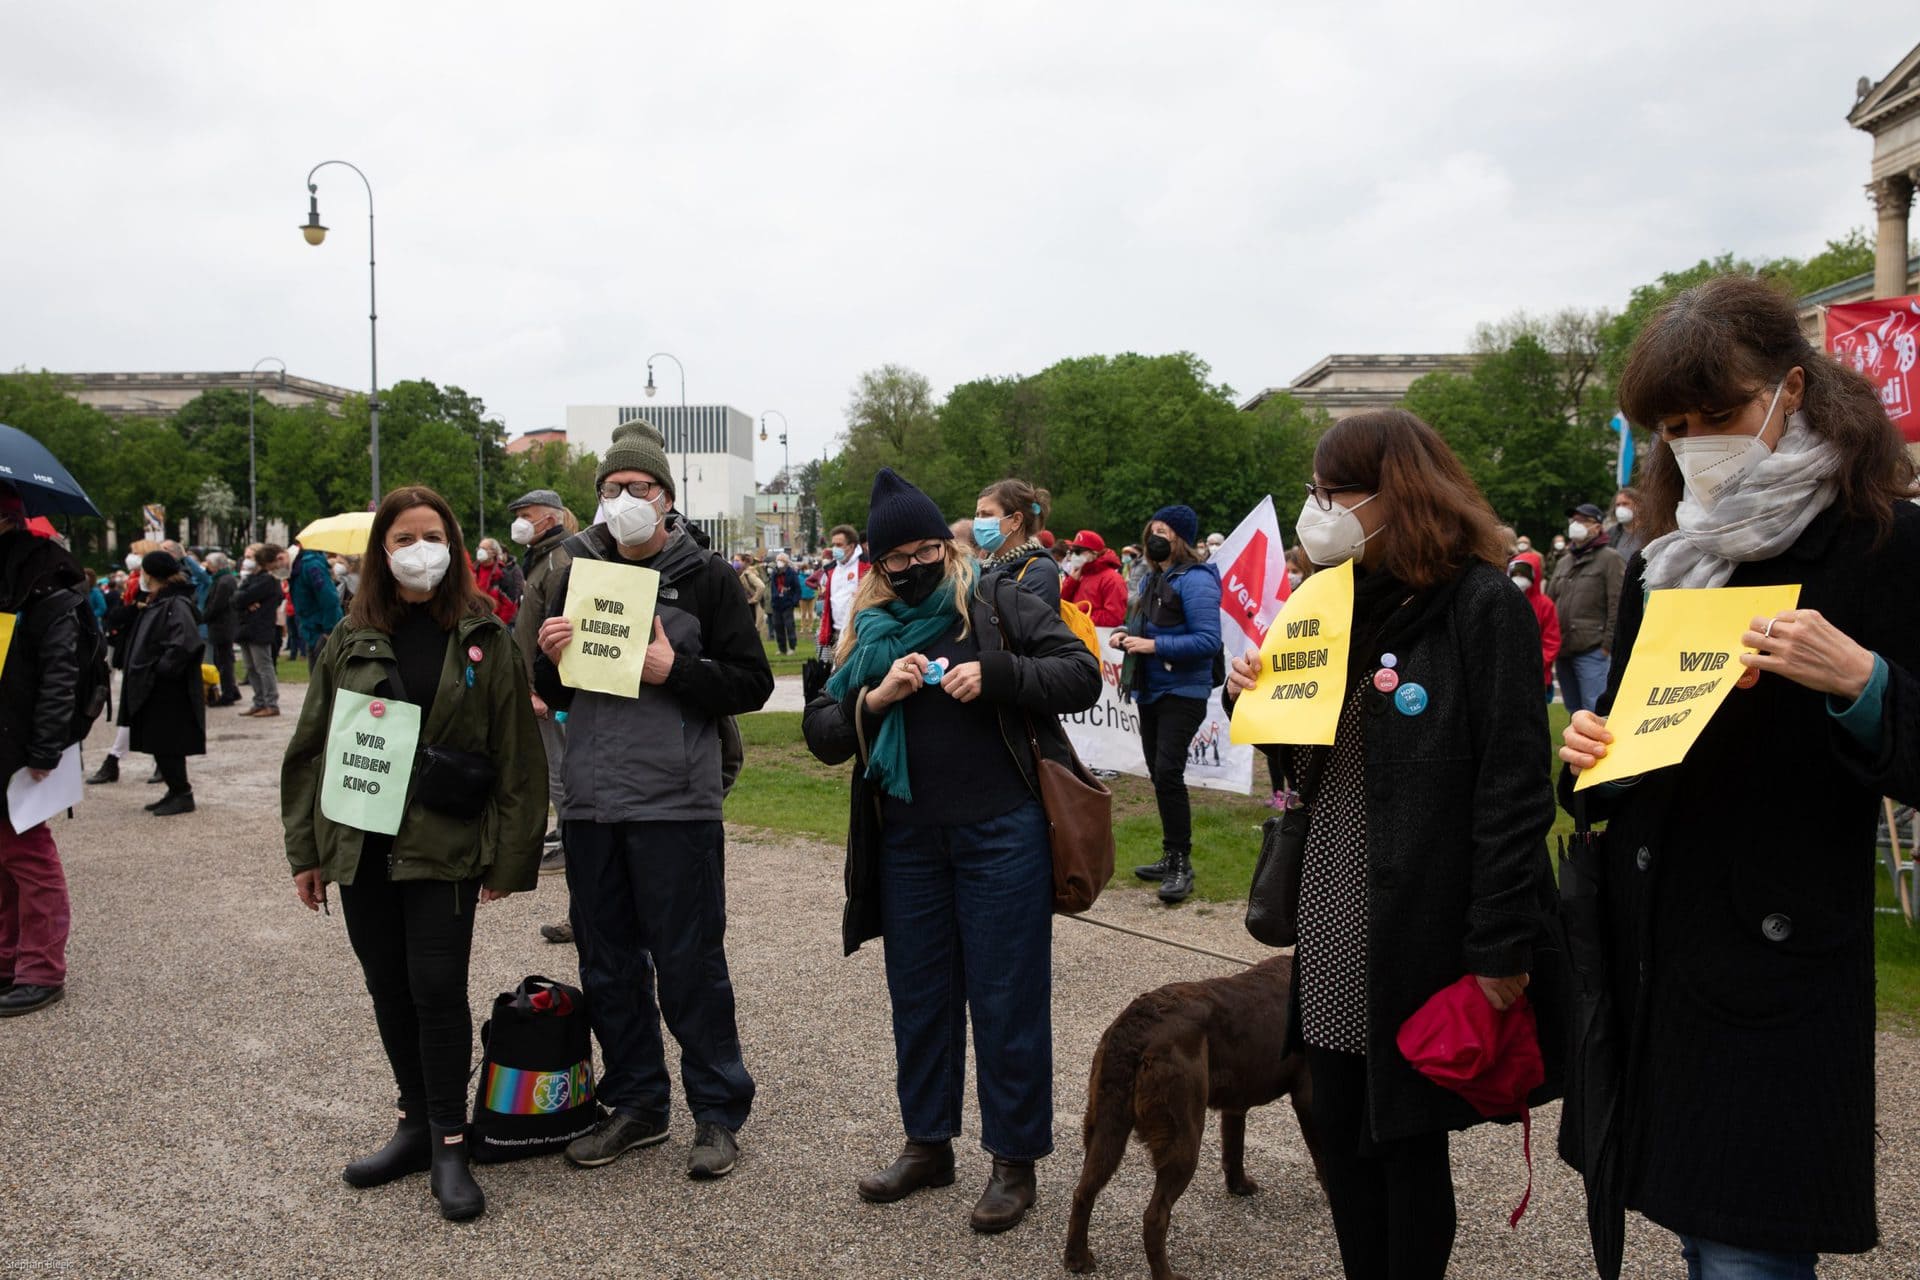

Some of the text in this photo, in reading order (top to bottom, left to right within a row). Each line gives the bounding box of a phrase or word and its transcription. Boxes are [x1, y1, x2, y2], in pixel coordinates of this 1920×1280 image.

[1881, 376, 1901, 405] di
[594, 598, 625, 615] WIR
[581, 618, 630, 639] LIEBEN
[1286, 618, 1320, 639] WIR
[582, 641, 621, 659] KINO
[1272, 648, 1329, 672] LIEBEN
[1679, 651, 1730, 672] WIR
[1271, 681, 1319, 700] KINO
[1646, 677, 1723, 706] LIEBEN
[1634, 708, 1692, 736] KINO
[356, 731, 386, 750] WIR
[342, 752, 391, 774] LIEBEN
[343, 775, 381, 795] KINO
[485, 1135, 528, 1146] International
[545, 1133, 571, 1143] Festival
